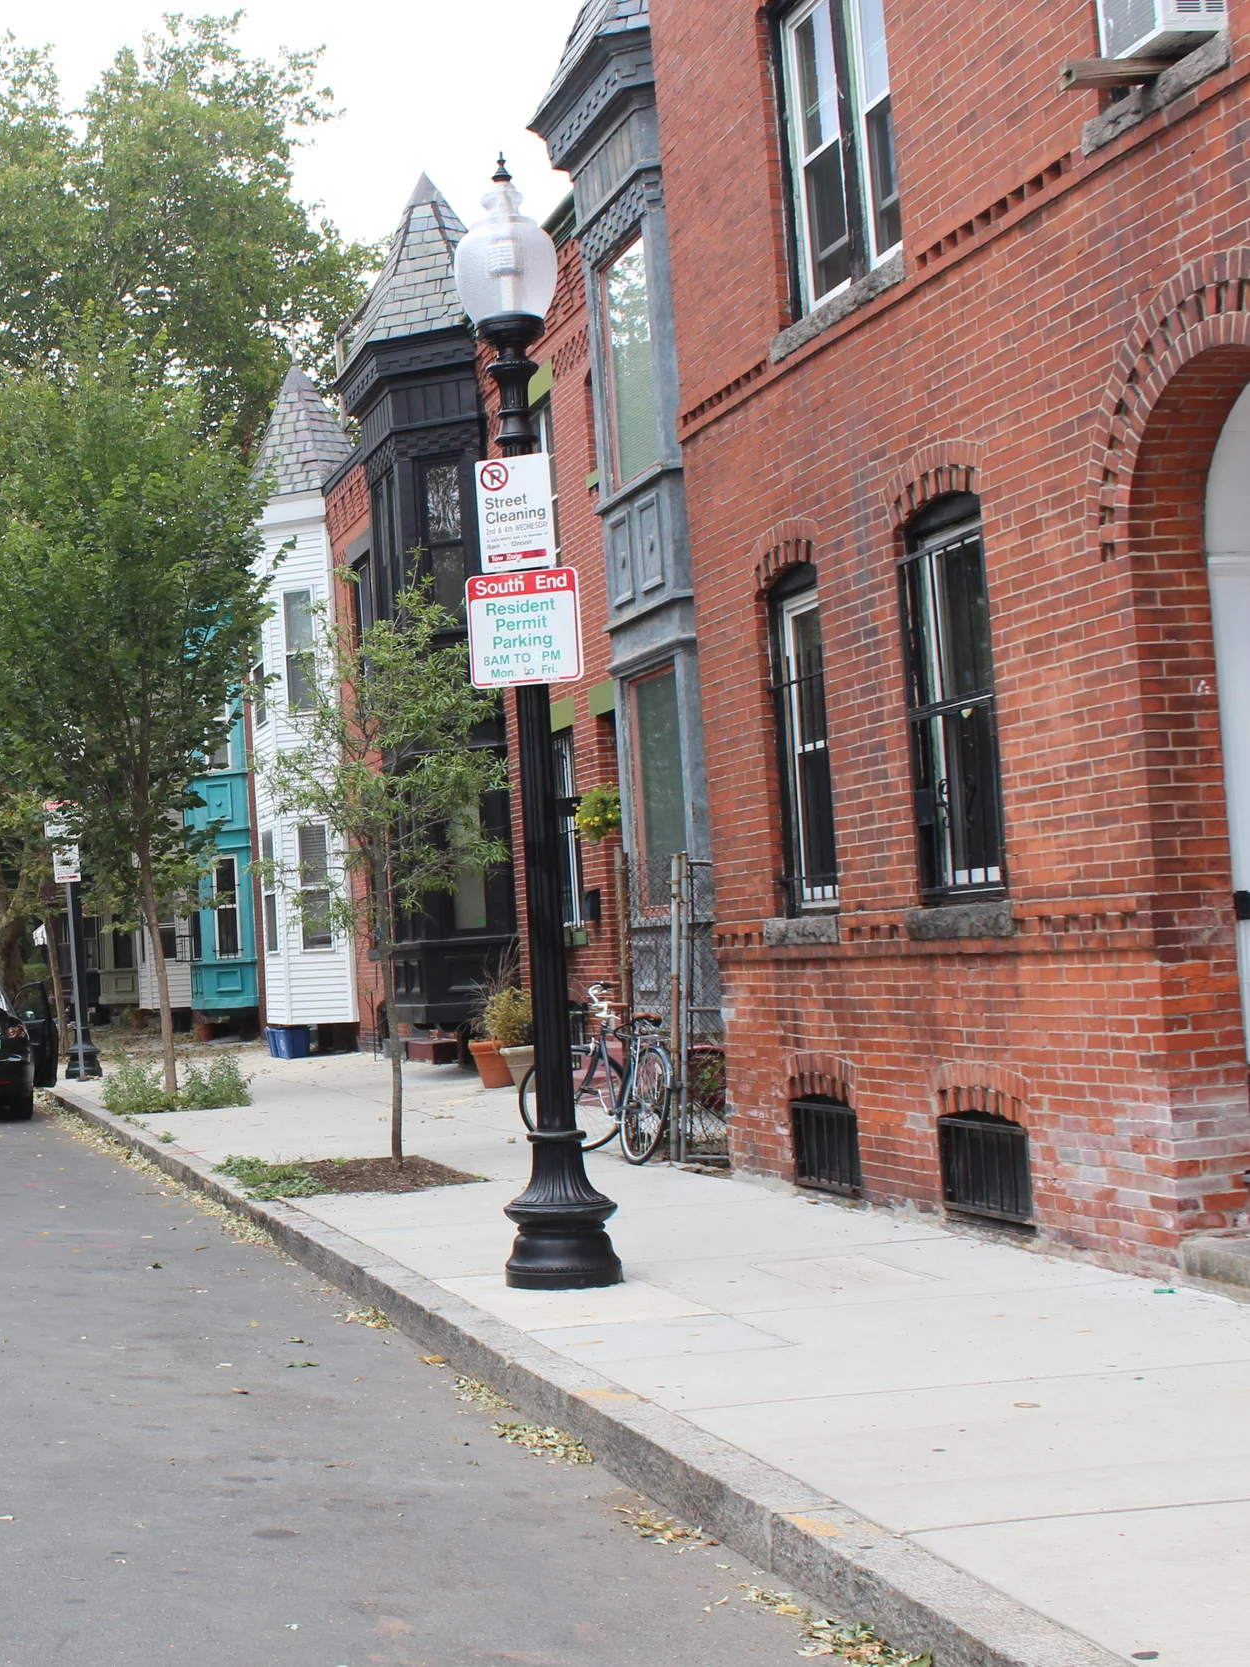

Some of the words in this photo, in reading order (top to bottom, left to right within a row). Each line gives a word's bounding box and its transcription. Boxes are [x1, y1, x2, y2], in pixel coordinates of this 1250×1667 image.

[485, 493, 527, 510] Street
[486, 508, 545, 524] Cleaning
[515, 521, 548, 531] WEDNESDAY
[511, 539, 532, 547] 12noon
[475, 577, 524, 596] South
[535, 573, 567, 590] End
[486, 598, 555, 616] Resident
[495, 615, 547, 632] Permit
[493, 633, 553, 649] Parking
[483, 654, 510, 666] 8AM
[513, 652, 530, 663] TO
[542, 650, 561, 661] PM
[491, 669, 517, 678] Mon.
[524, 666, 534, 675] to
[542, 664, 558, 674] Fri.
